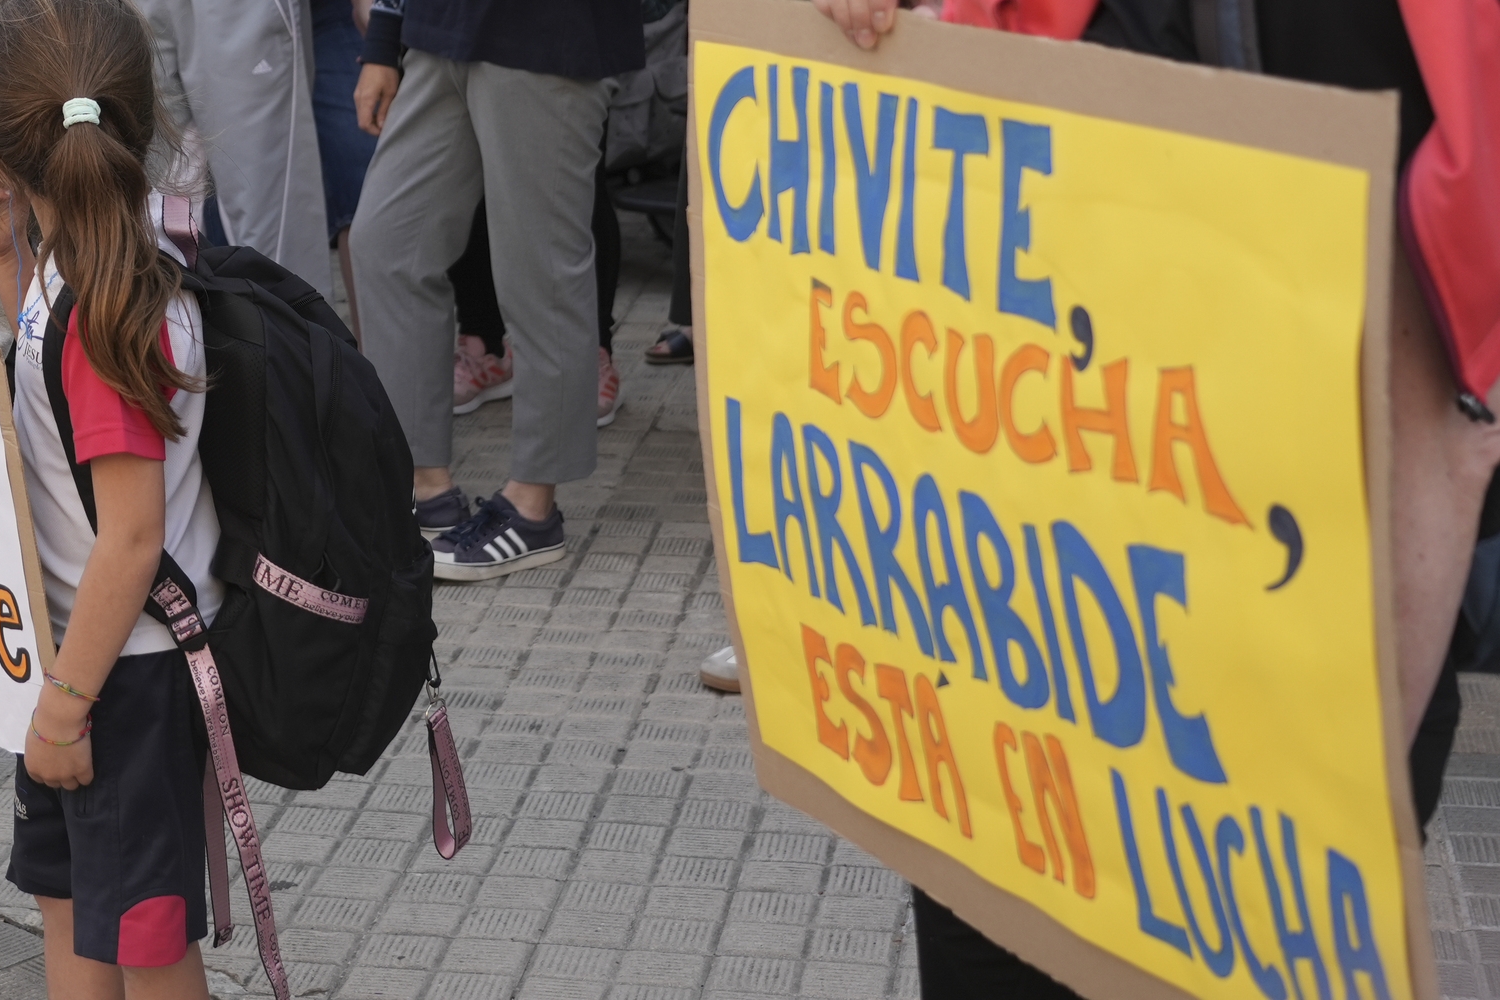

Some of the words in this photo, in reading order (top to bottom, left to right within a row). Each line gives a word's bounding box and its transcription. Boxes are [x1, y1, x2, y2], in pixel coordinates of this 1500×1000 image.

[706, 61, 1094, 371] CHIVITE,
[808, 278, 1305, 591] ESCUCHA,
[724, 395, 1228, 785] LARRABIDE
[222, 776, 258, 849] SHOW
[246, 854, 272, 926] TIME
[993, 719, 1096, 901] EN
[1110, 765, 1394, 1000] LUCHA
